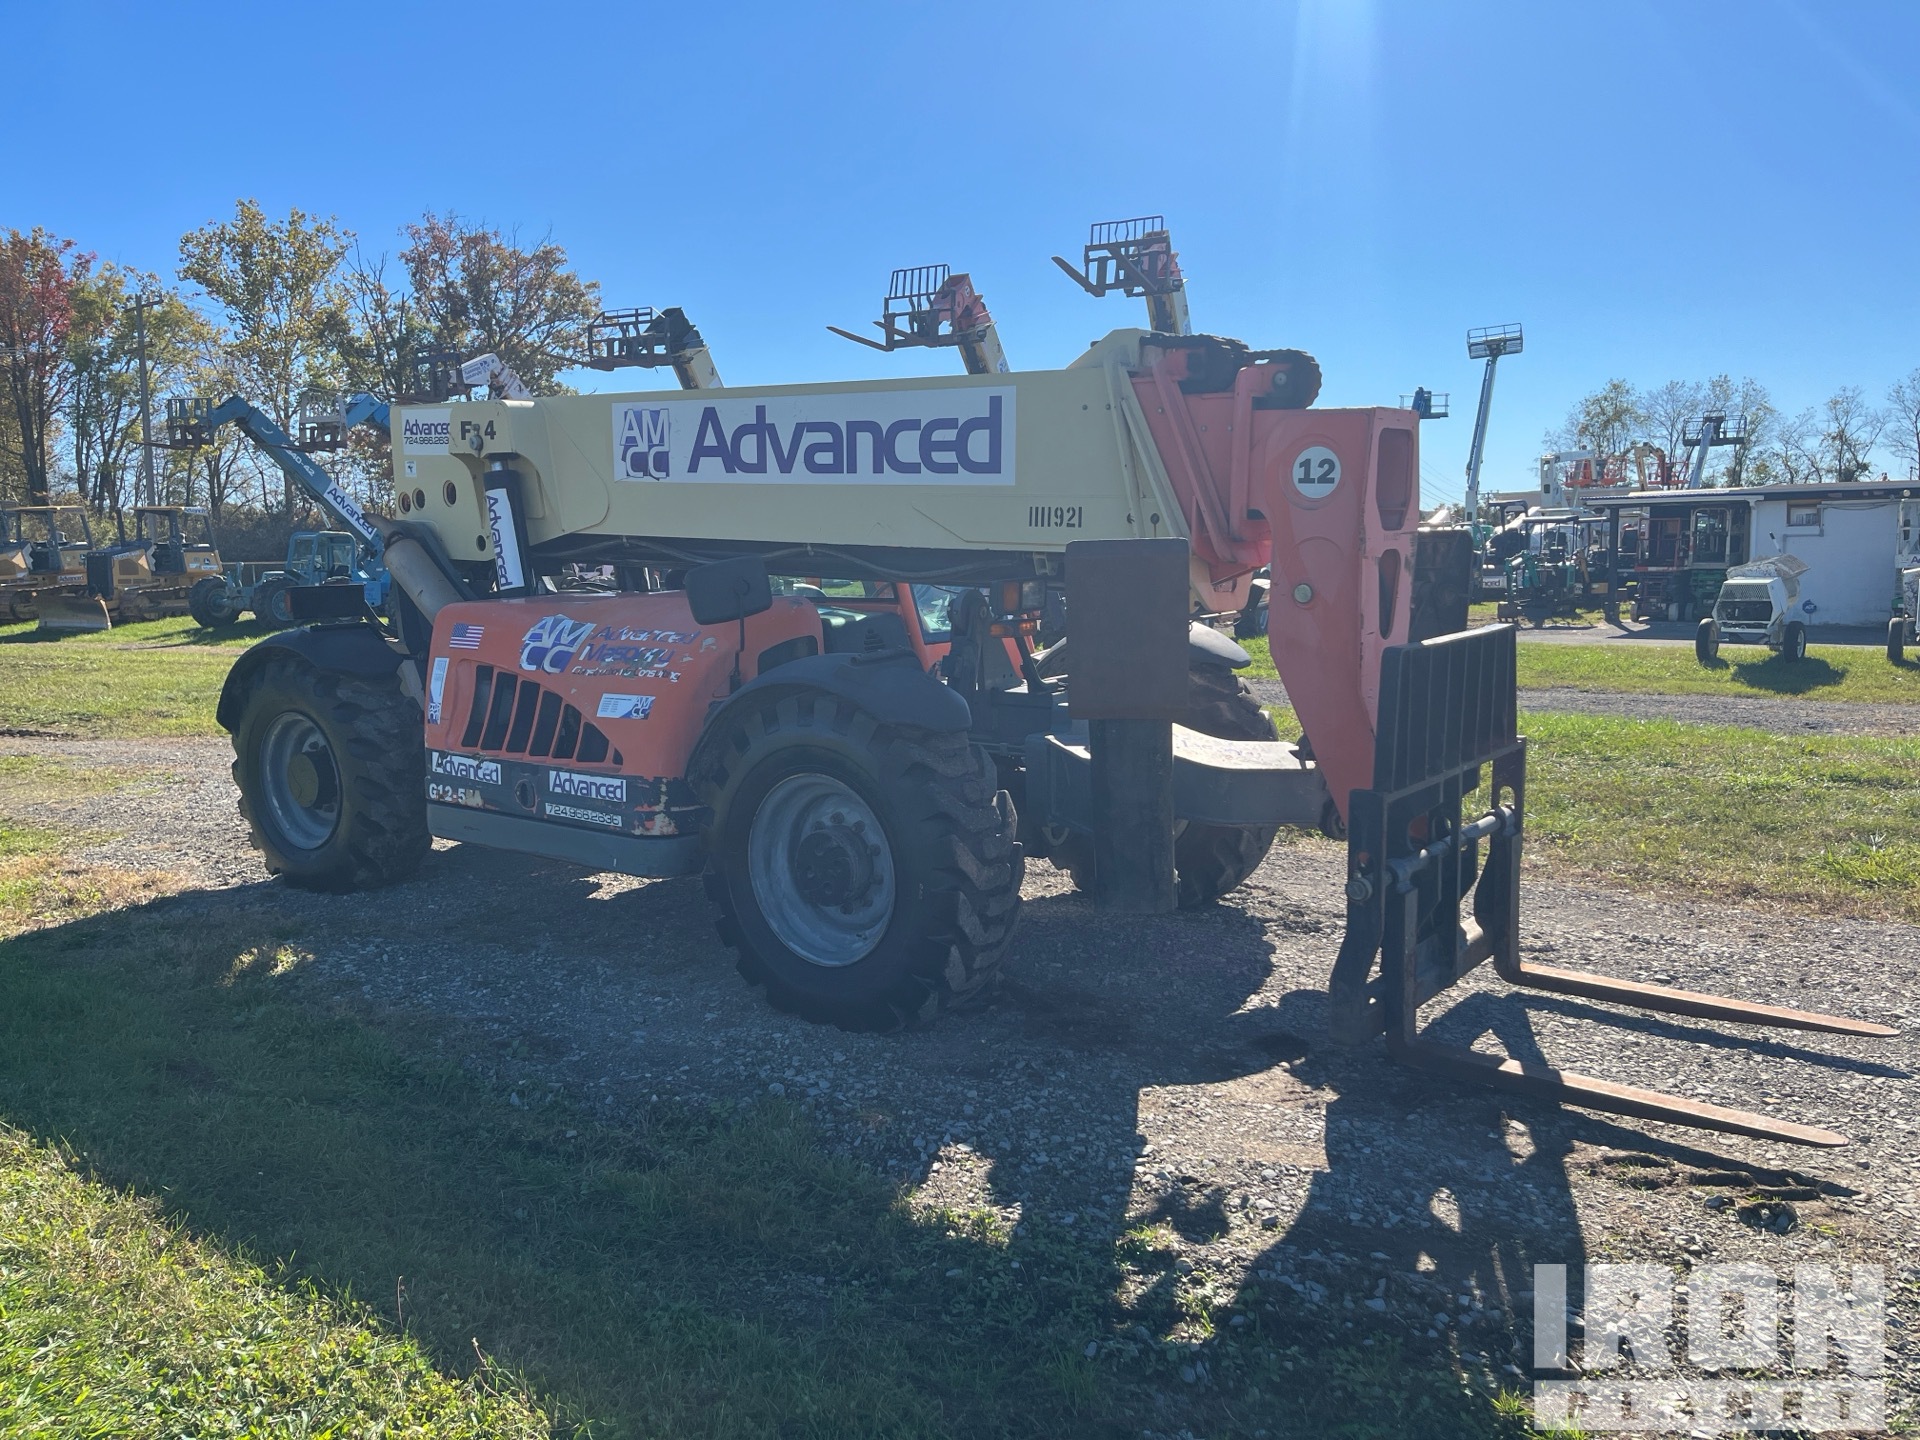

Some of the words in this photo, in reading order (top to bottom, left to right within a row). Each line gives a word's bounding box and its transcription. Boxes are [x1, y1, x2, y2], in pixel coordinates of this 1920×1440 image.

[404, 419, 450, 435] Advance
[687, 396, 1002, 474] Advanced
[1298, 458, 1335, 484] 12
[327, 487, 375, 536] Advanced
[486, 495, 513, 587] Advanced
[435, 753, 499, 784] Advanced
[552, 772, 625, 801] Advanced
